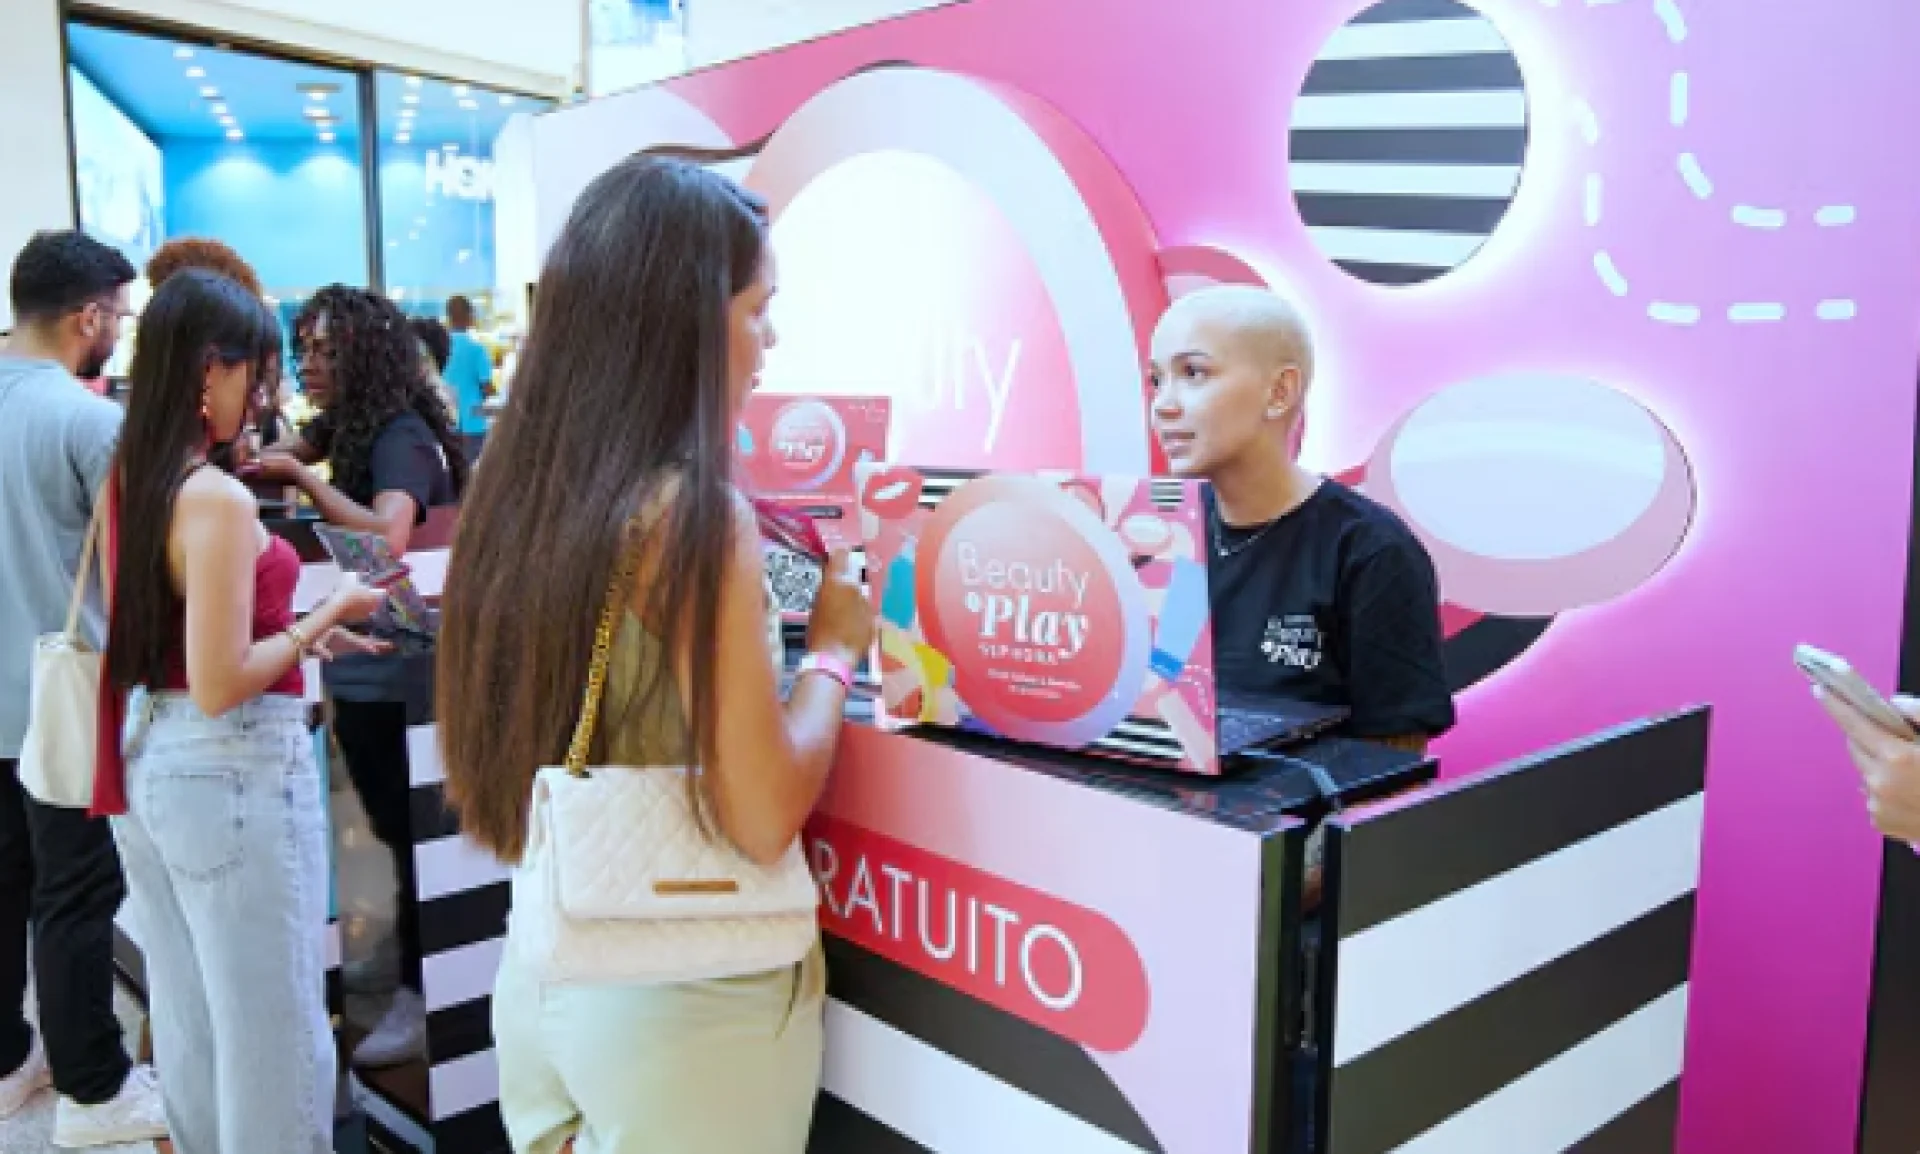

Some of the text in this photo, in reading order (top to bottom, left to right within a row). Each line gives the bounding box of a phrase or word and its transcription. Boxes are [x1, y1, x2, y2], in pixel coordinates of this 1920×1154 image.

[957, 540, 1090, 610] Beauty
[965, 591, 1090, 660] Play
[812, 837, 1083, 1011] RATUITO
